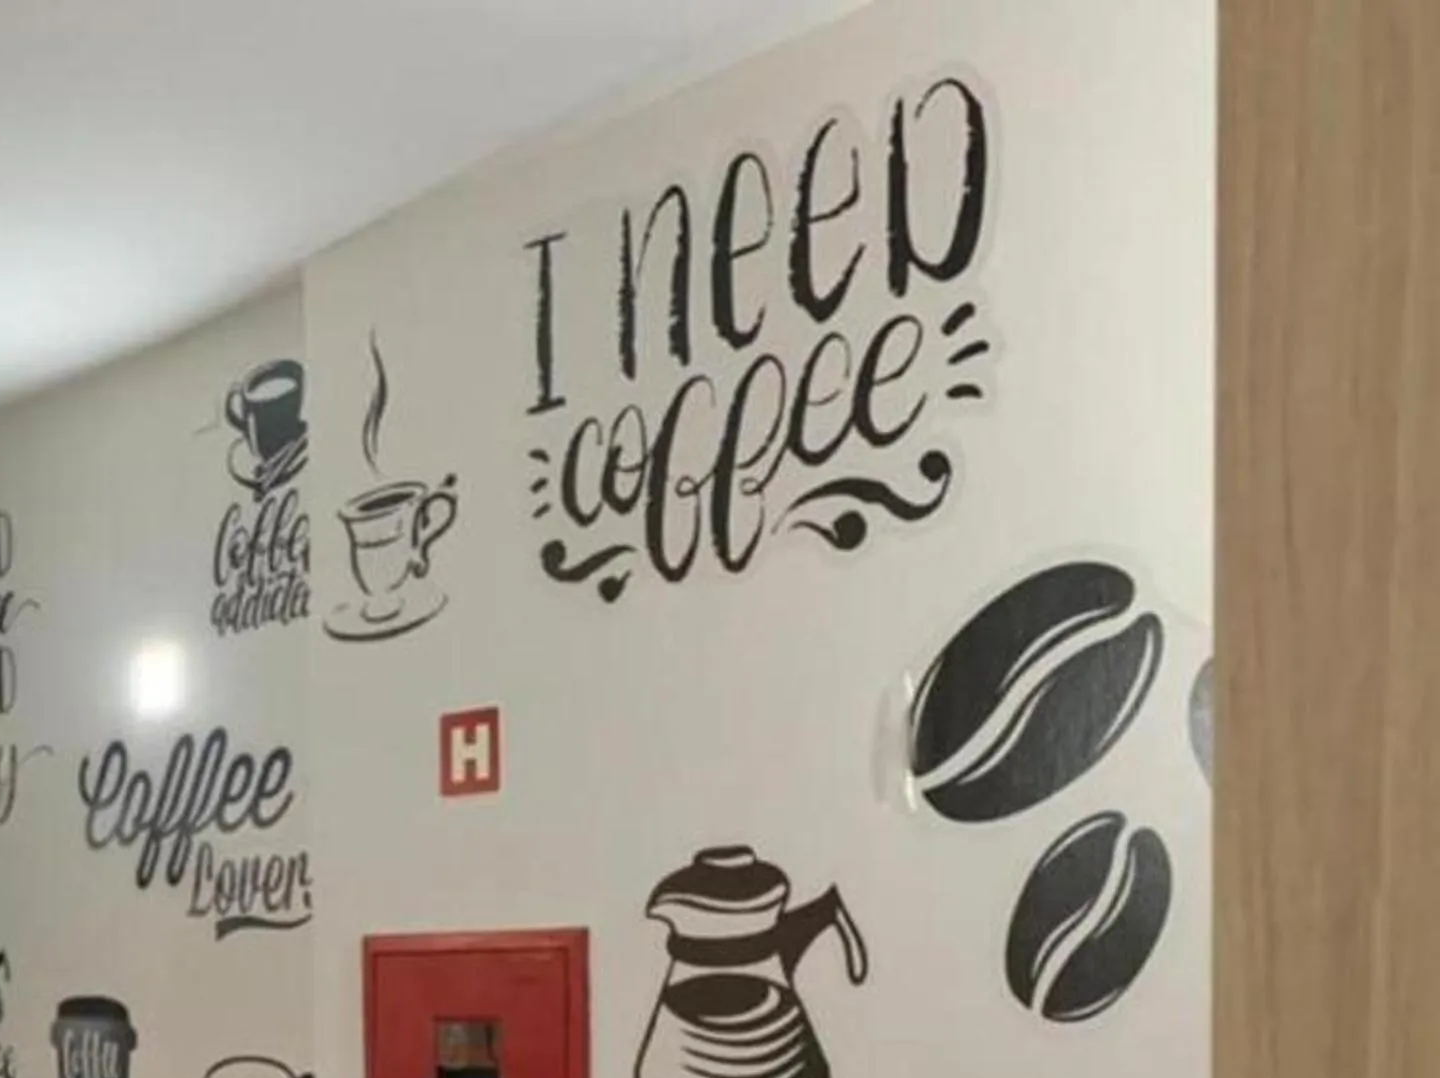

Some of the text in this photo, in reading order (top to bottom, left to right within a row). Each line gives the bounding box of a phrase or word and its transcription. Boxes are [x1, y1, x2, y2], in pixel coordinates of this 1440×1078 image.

[524, 233, 567, 415] I
[562, 314, 927, 583] coffee
[78, 726, 294, 890] Coffee
[450, 722, 490, 783] H
